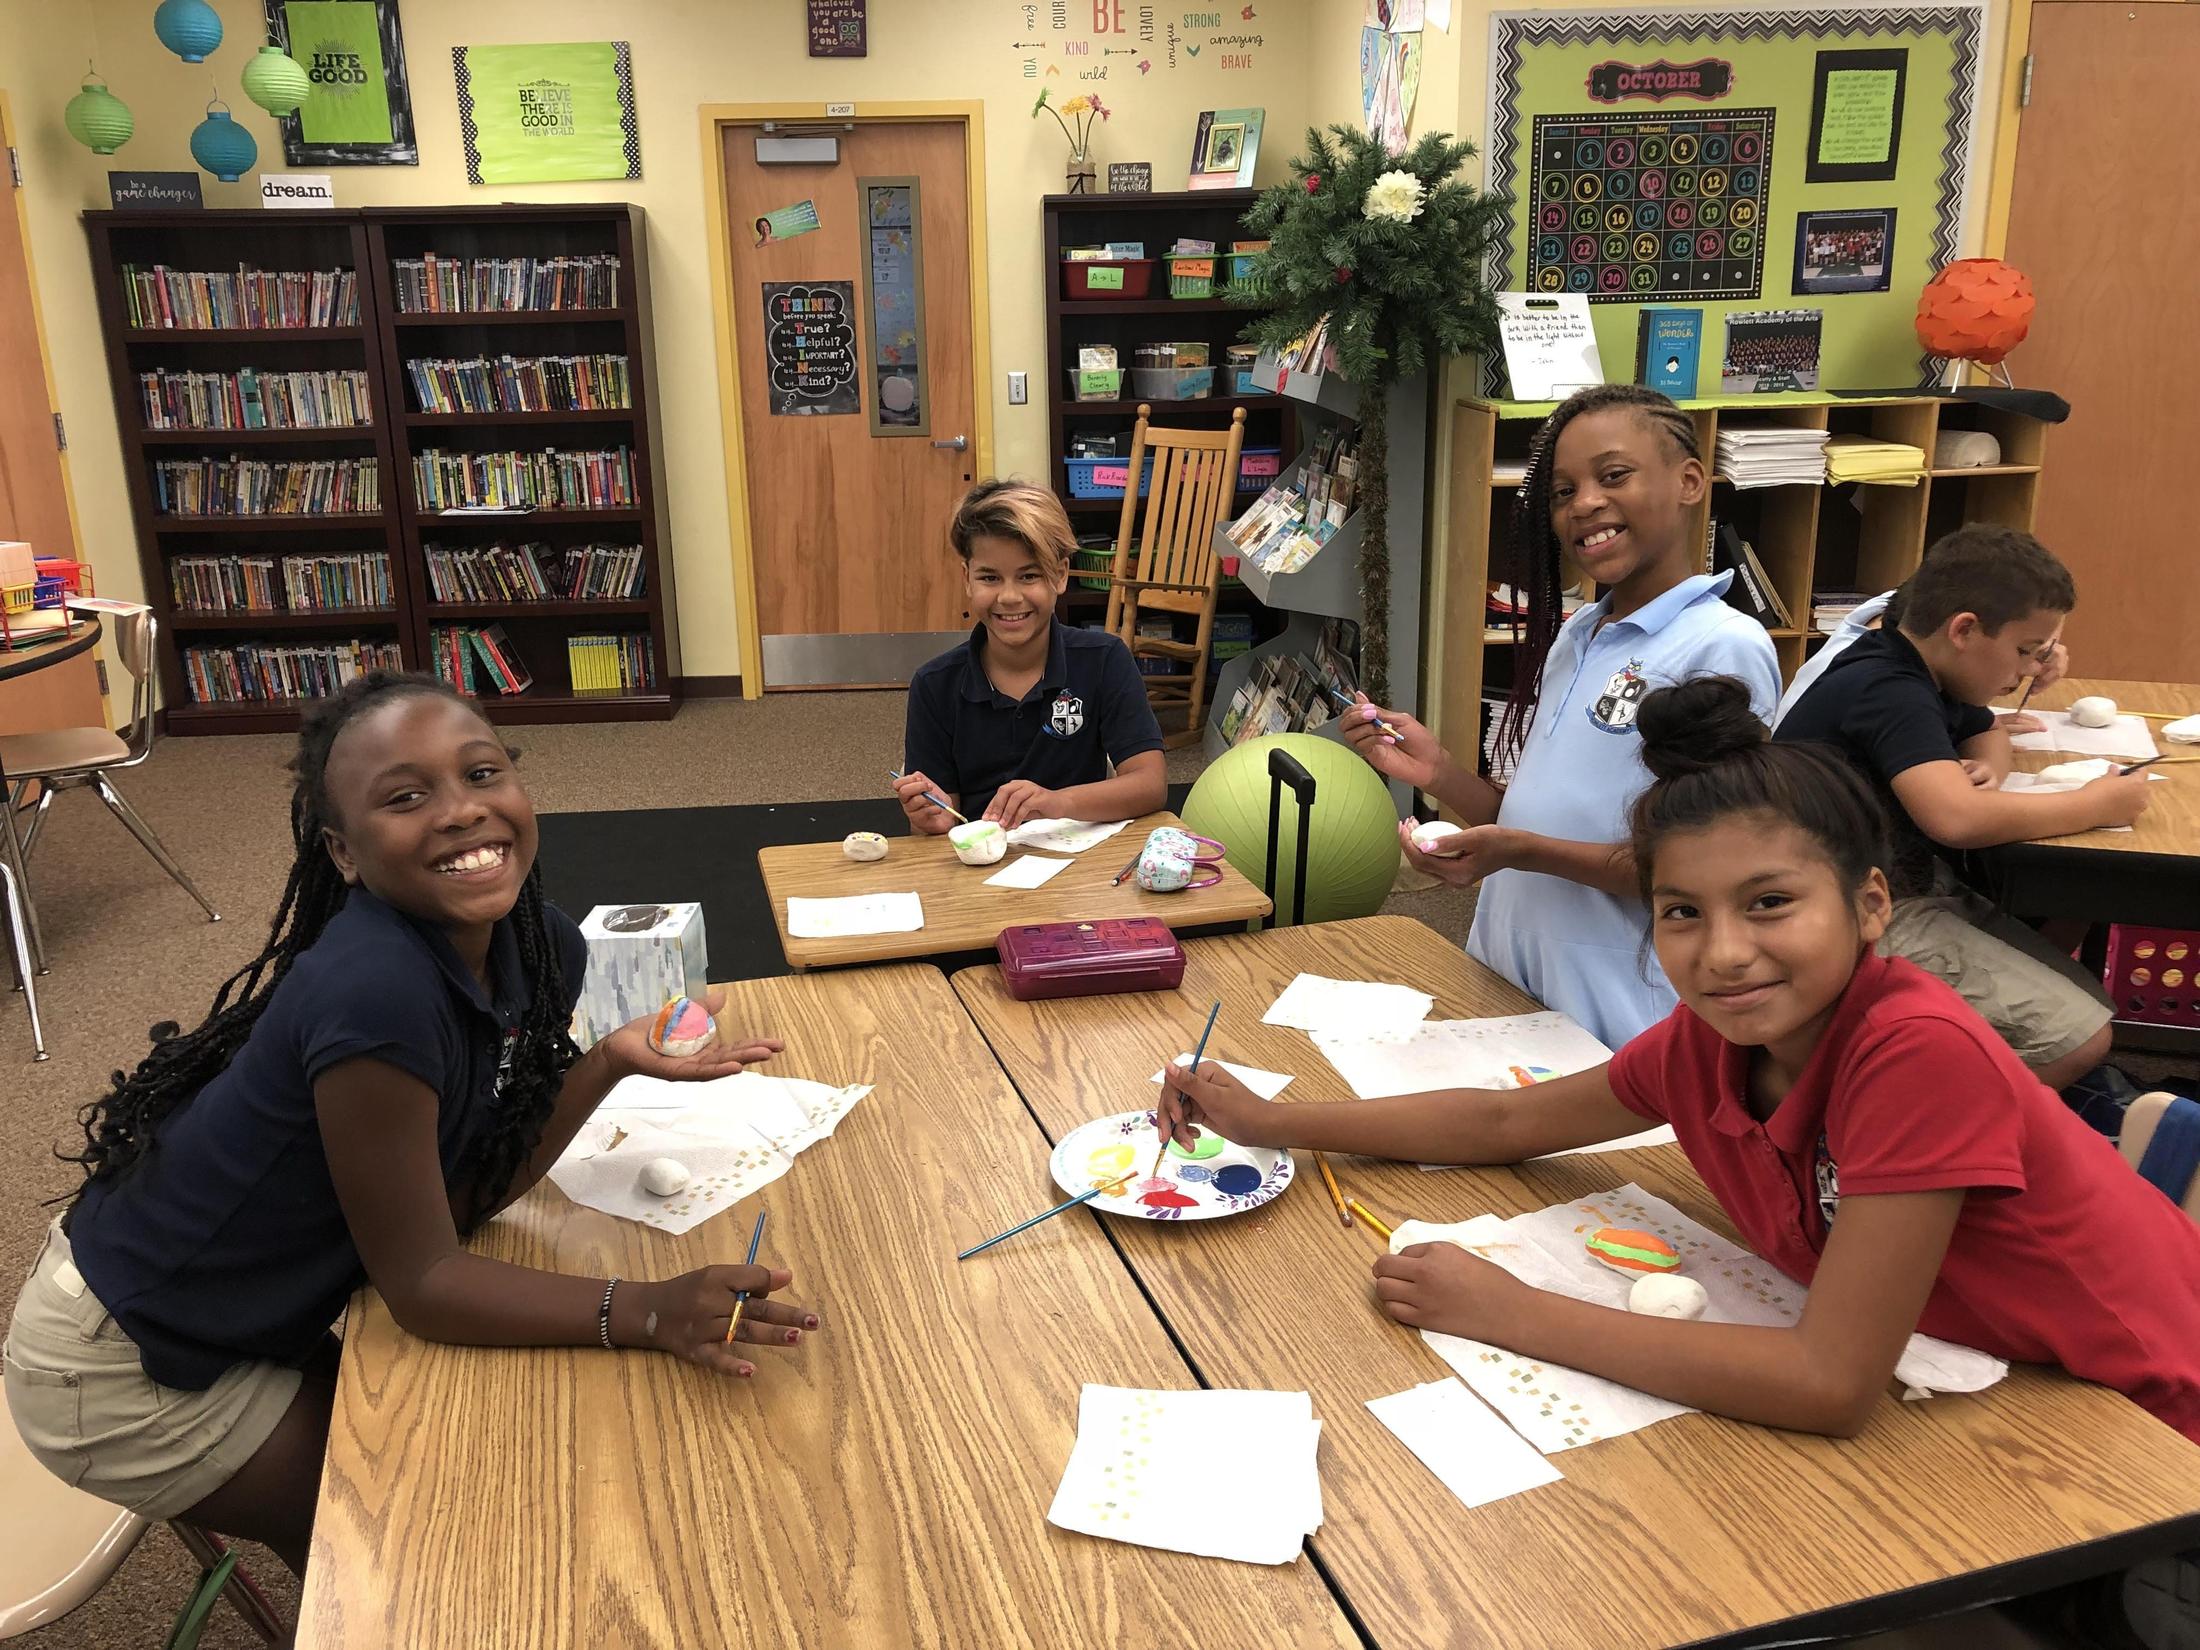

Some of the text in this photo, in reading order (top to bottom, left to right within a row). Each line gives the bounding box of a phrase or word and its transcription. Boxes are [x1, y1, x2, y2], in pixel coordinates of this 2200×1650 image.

[813, 8, 864, 20] you are be
[1093, 0, 1126, 34] BE
[1183, 12, 1221, 28] STRONG
[812, 24, 836, 39] good
[1140, 5, 1153, 43] LOVELY
[820, 37, 838, 45] one
[1065, 41, 1088, 55] KIND
[1167, 22, 1181, 68] unique
[1210, 34, 1264, 48] amazing
[312, 53, 360, 68] LIFE
[1023, 58, 1037, 78] YOU
[1221, 54, 1252, 69] BRAVE
[308, 68, 369, 84] GOOD
[1080, 65, 1108, 80] wild
[1617, 71, 1701, 90] OCTOBER
[518, 89, 571, 102] BELIEVE
[520, 102, 573, 114] THERE IS
[830, 106, 850, 114] 4-207
[521, 115, 574, 127] GOOD IN
[523, 127, 575, 136] THE WORLD
[1587, 141, 1752, 160] 1 2 3 4 5 6
[262, 182, 333, 198] dream.
[1552, 175, 1754, 194] 7 8 9 10 11 12 13
[115, 186, 197, 202] game changer
[1546, 206, 1751, 225] 14 15 16 17 18 19 20
[1543, 236, 1751, 257] 21 22 23 24 25 26 27
[1092, 273, 1117, 282] A L
[1544, 272, 1651, 287] 28 29 30 31
[780, 297, 836, 313] THINK
[1522, 313, 1541, 321] better
[1755, 317, 1784, 325] Academy
[795, 322, 830, 335] True?
[1547, 323, 1568, 331] friend
[796, 336, 841, 349] Helpful?
[799, 348, 845, 360] IMPORTANT?
[797, 361, 851, 375] Necessary?
[798, 375, 831, 387] Kind?
